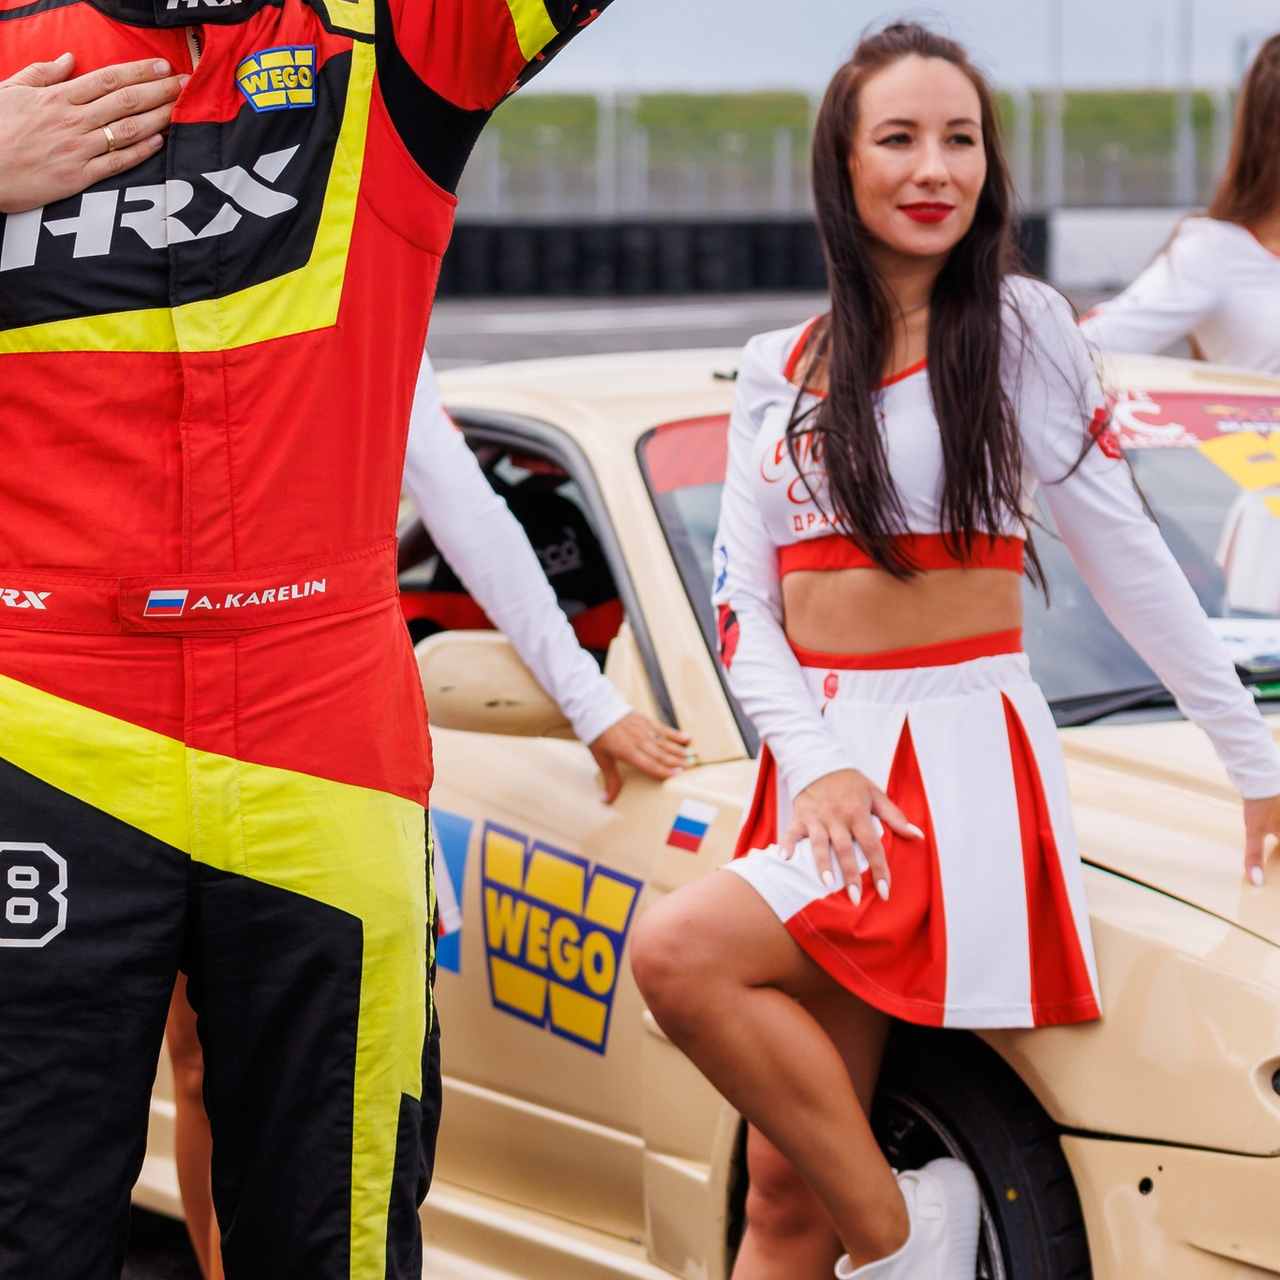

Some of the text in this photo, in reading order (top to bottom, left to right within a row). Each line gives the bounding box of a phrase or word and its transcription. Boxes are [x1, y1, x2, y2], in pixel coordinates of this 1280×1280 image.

[241, 66, 313, 95] WEGO
[0, 144, 300, 272] HRX
[483, 886, 617, 997] WEGO
